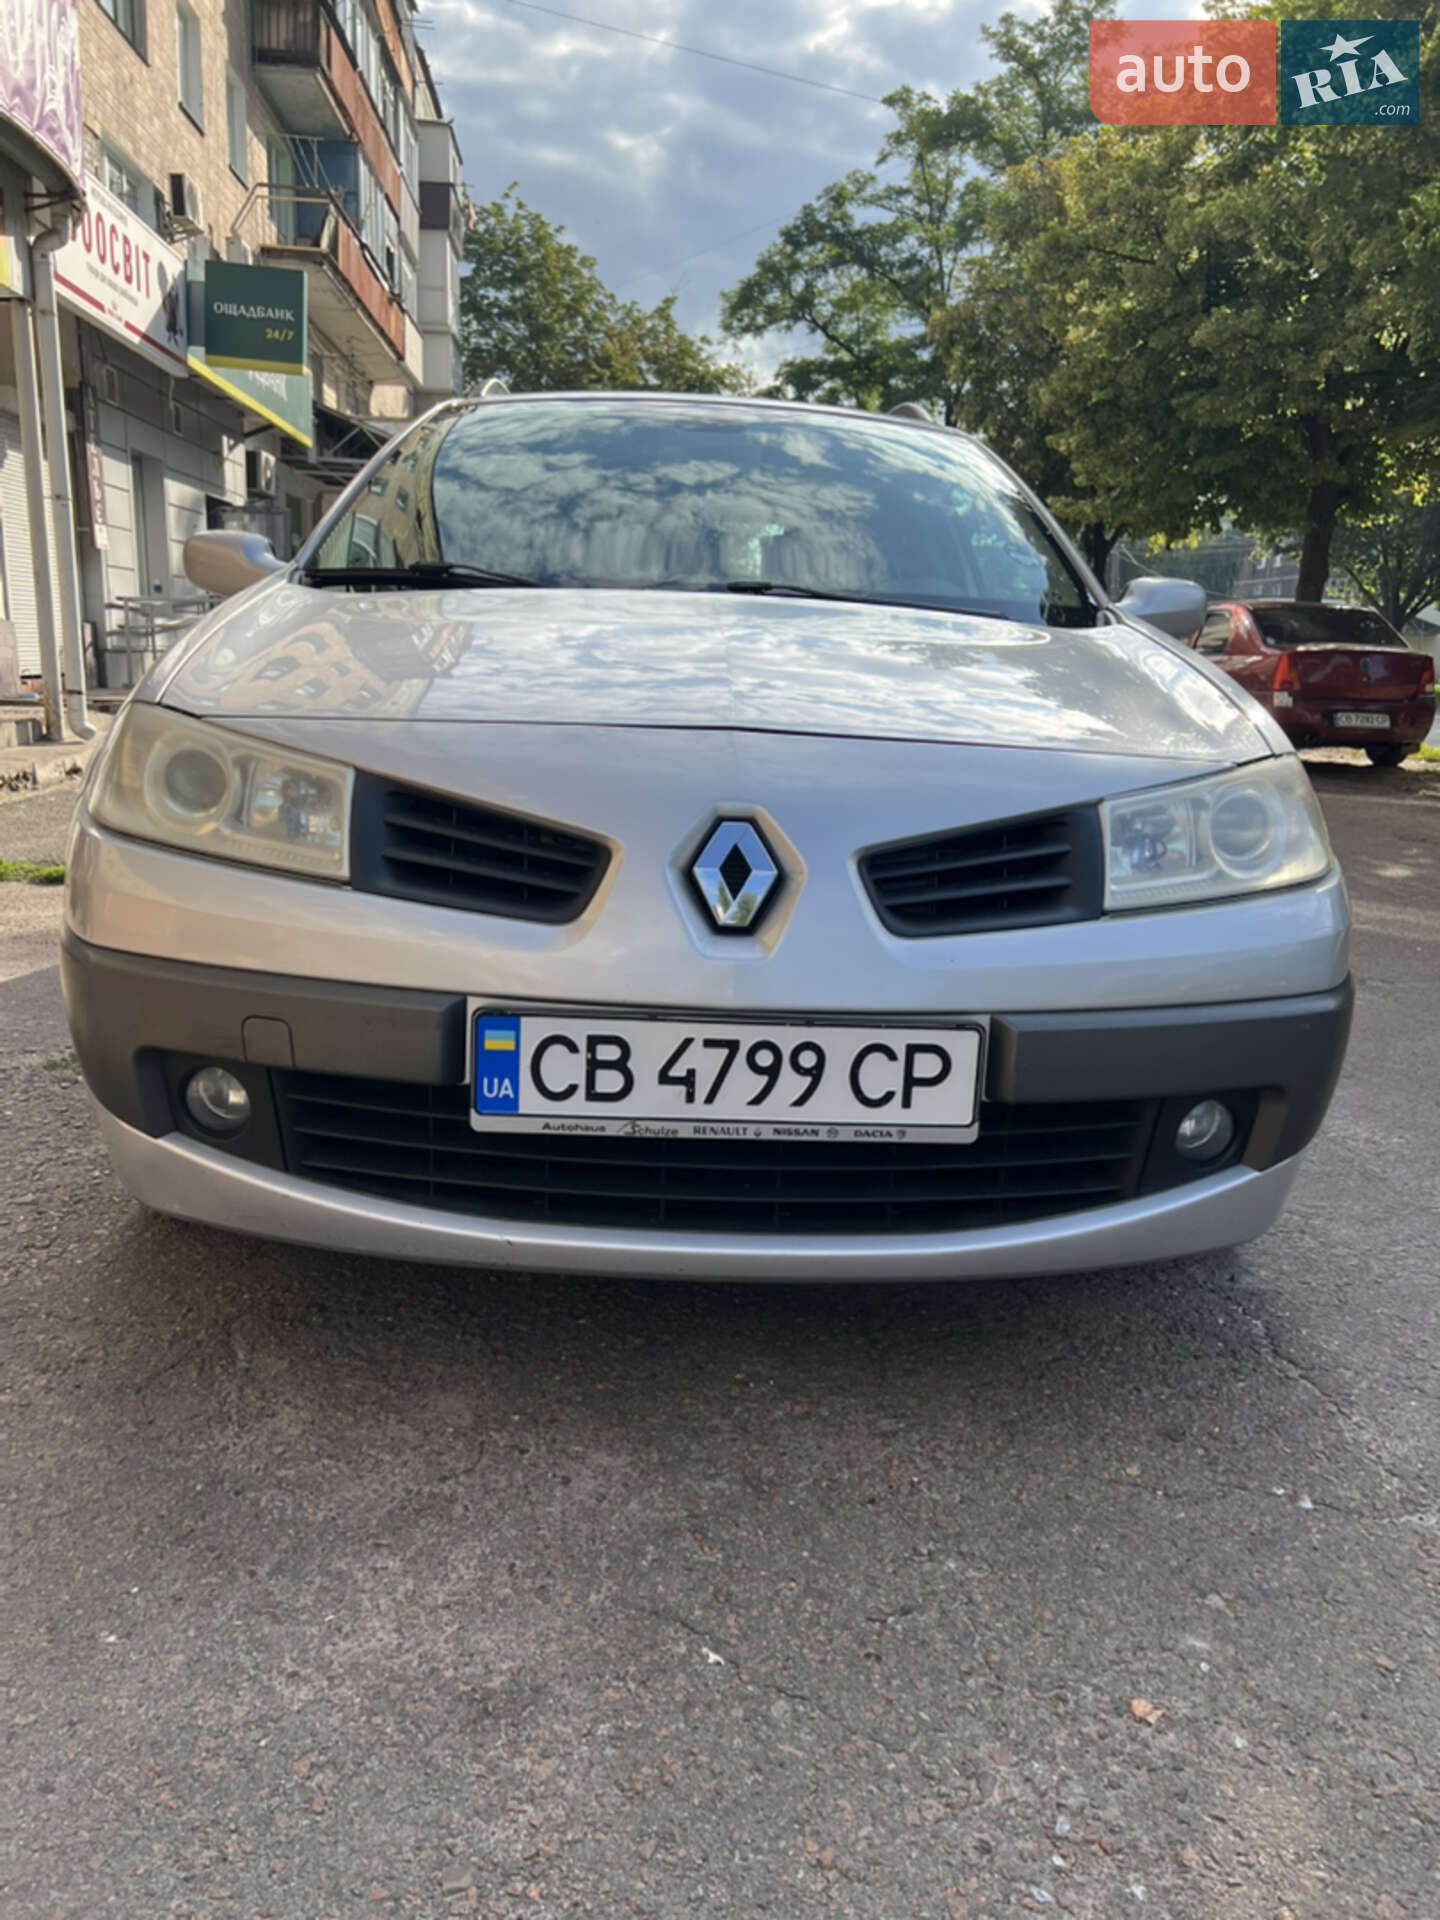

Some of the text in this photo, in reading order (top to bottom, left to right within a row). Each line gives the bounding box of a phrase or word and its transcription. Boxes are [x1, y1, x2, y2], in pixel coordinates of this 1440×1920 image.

[71, 203, 150, 300] ООСВІТ
[213, 301, 295, 321] ОЩАДБАНК
[265, 328, 294, 343] 24/7
[529, 1034, 952, 1109] CB 4799 CP
[482, 1077, 515, 1100] UA
[542, 1121, 606, 1133] Autohaus
[692, 1125, 893, 1139] RENAULT NISSAN DACIA
